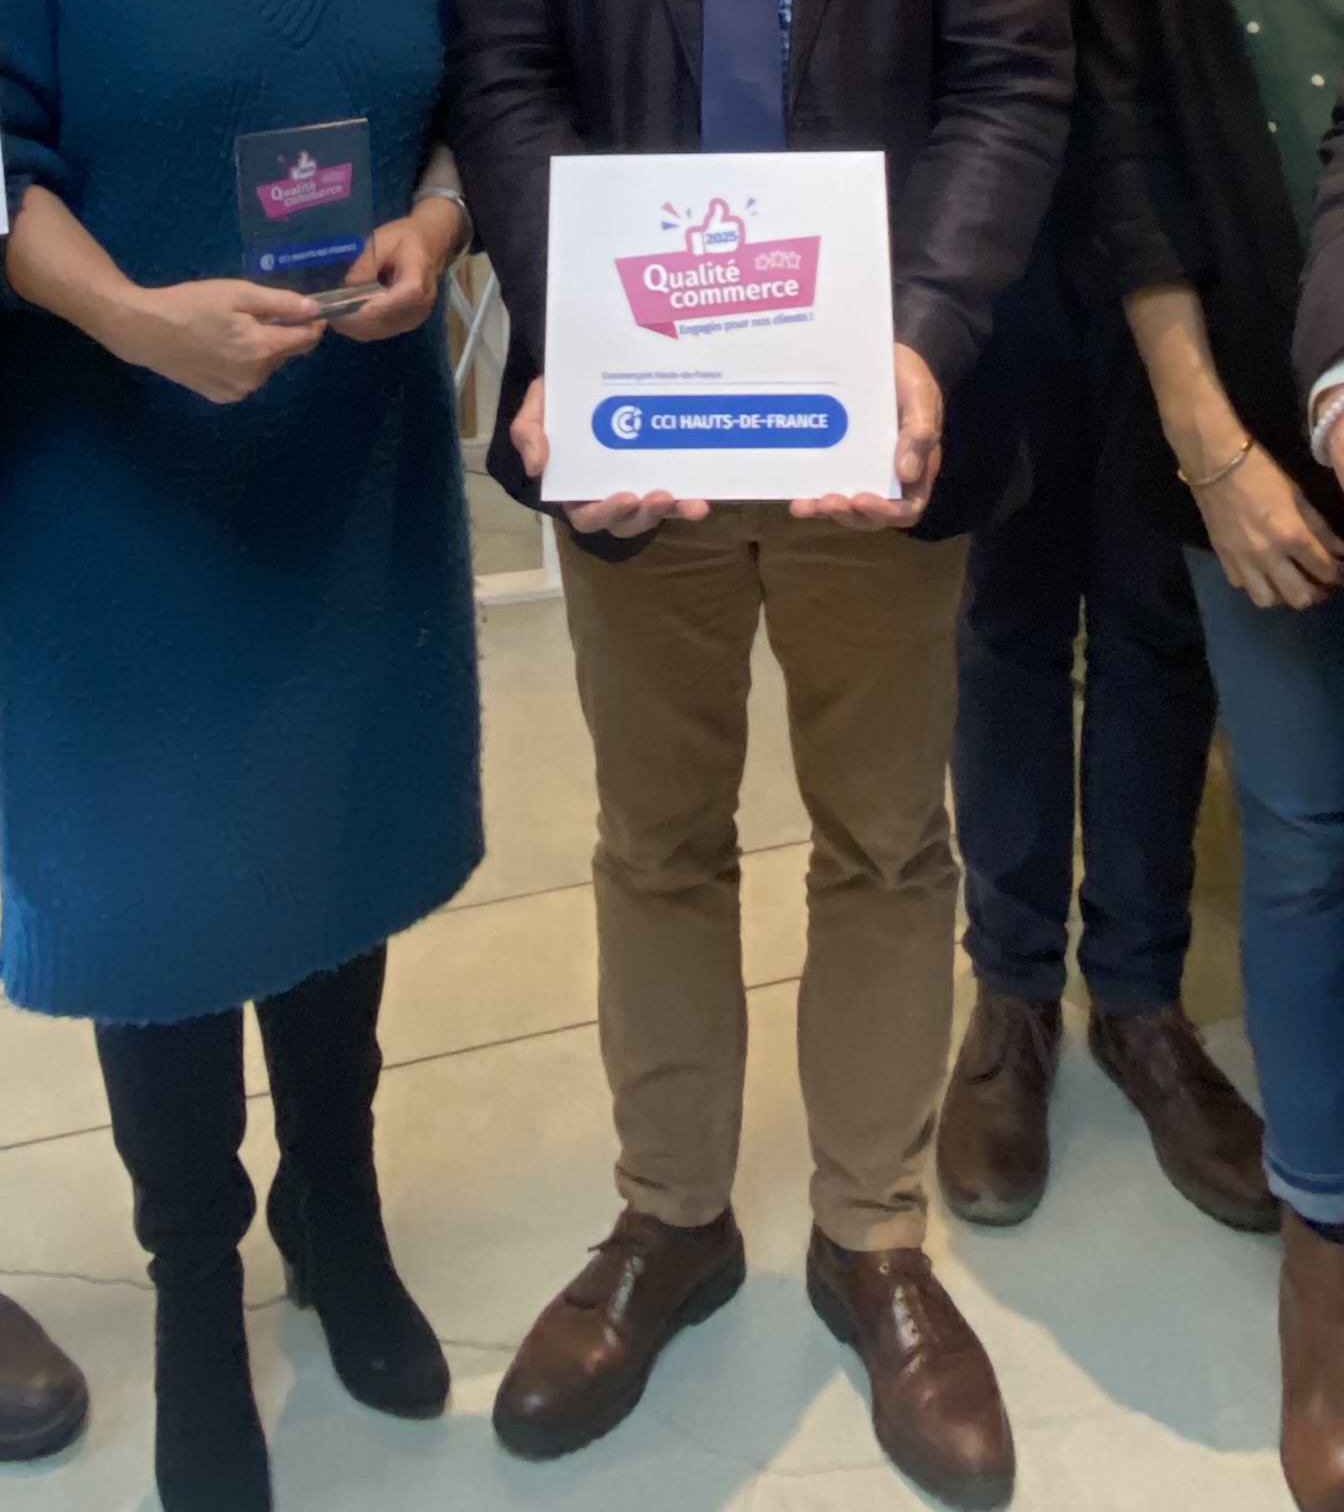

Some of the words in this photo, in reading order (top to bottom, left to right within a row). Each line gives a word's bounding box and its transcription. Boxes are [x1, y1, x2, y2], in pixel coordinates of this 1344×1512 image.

[706, 231, 738, 245] 2025
[643, 259, 741, 293] Qualité
[669, 279, 800, 309] commerce
[724, 319, 750, 333] pour
[651, 414, 677, 430] CCI
[680, 413, 830, 430] HAUTS-DE-FRANCE
